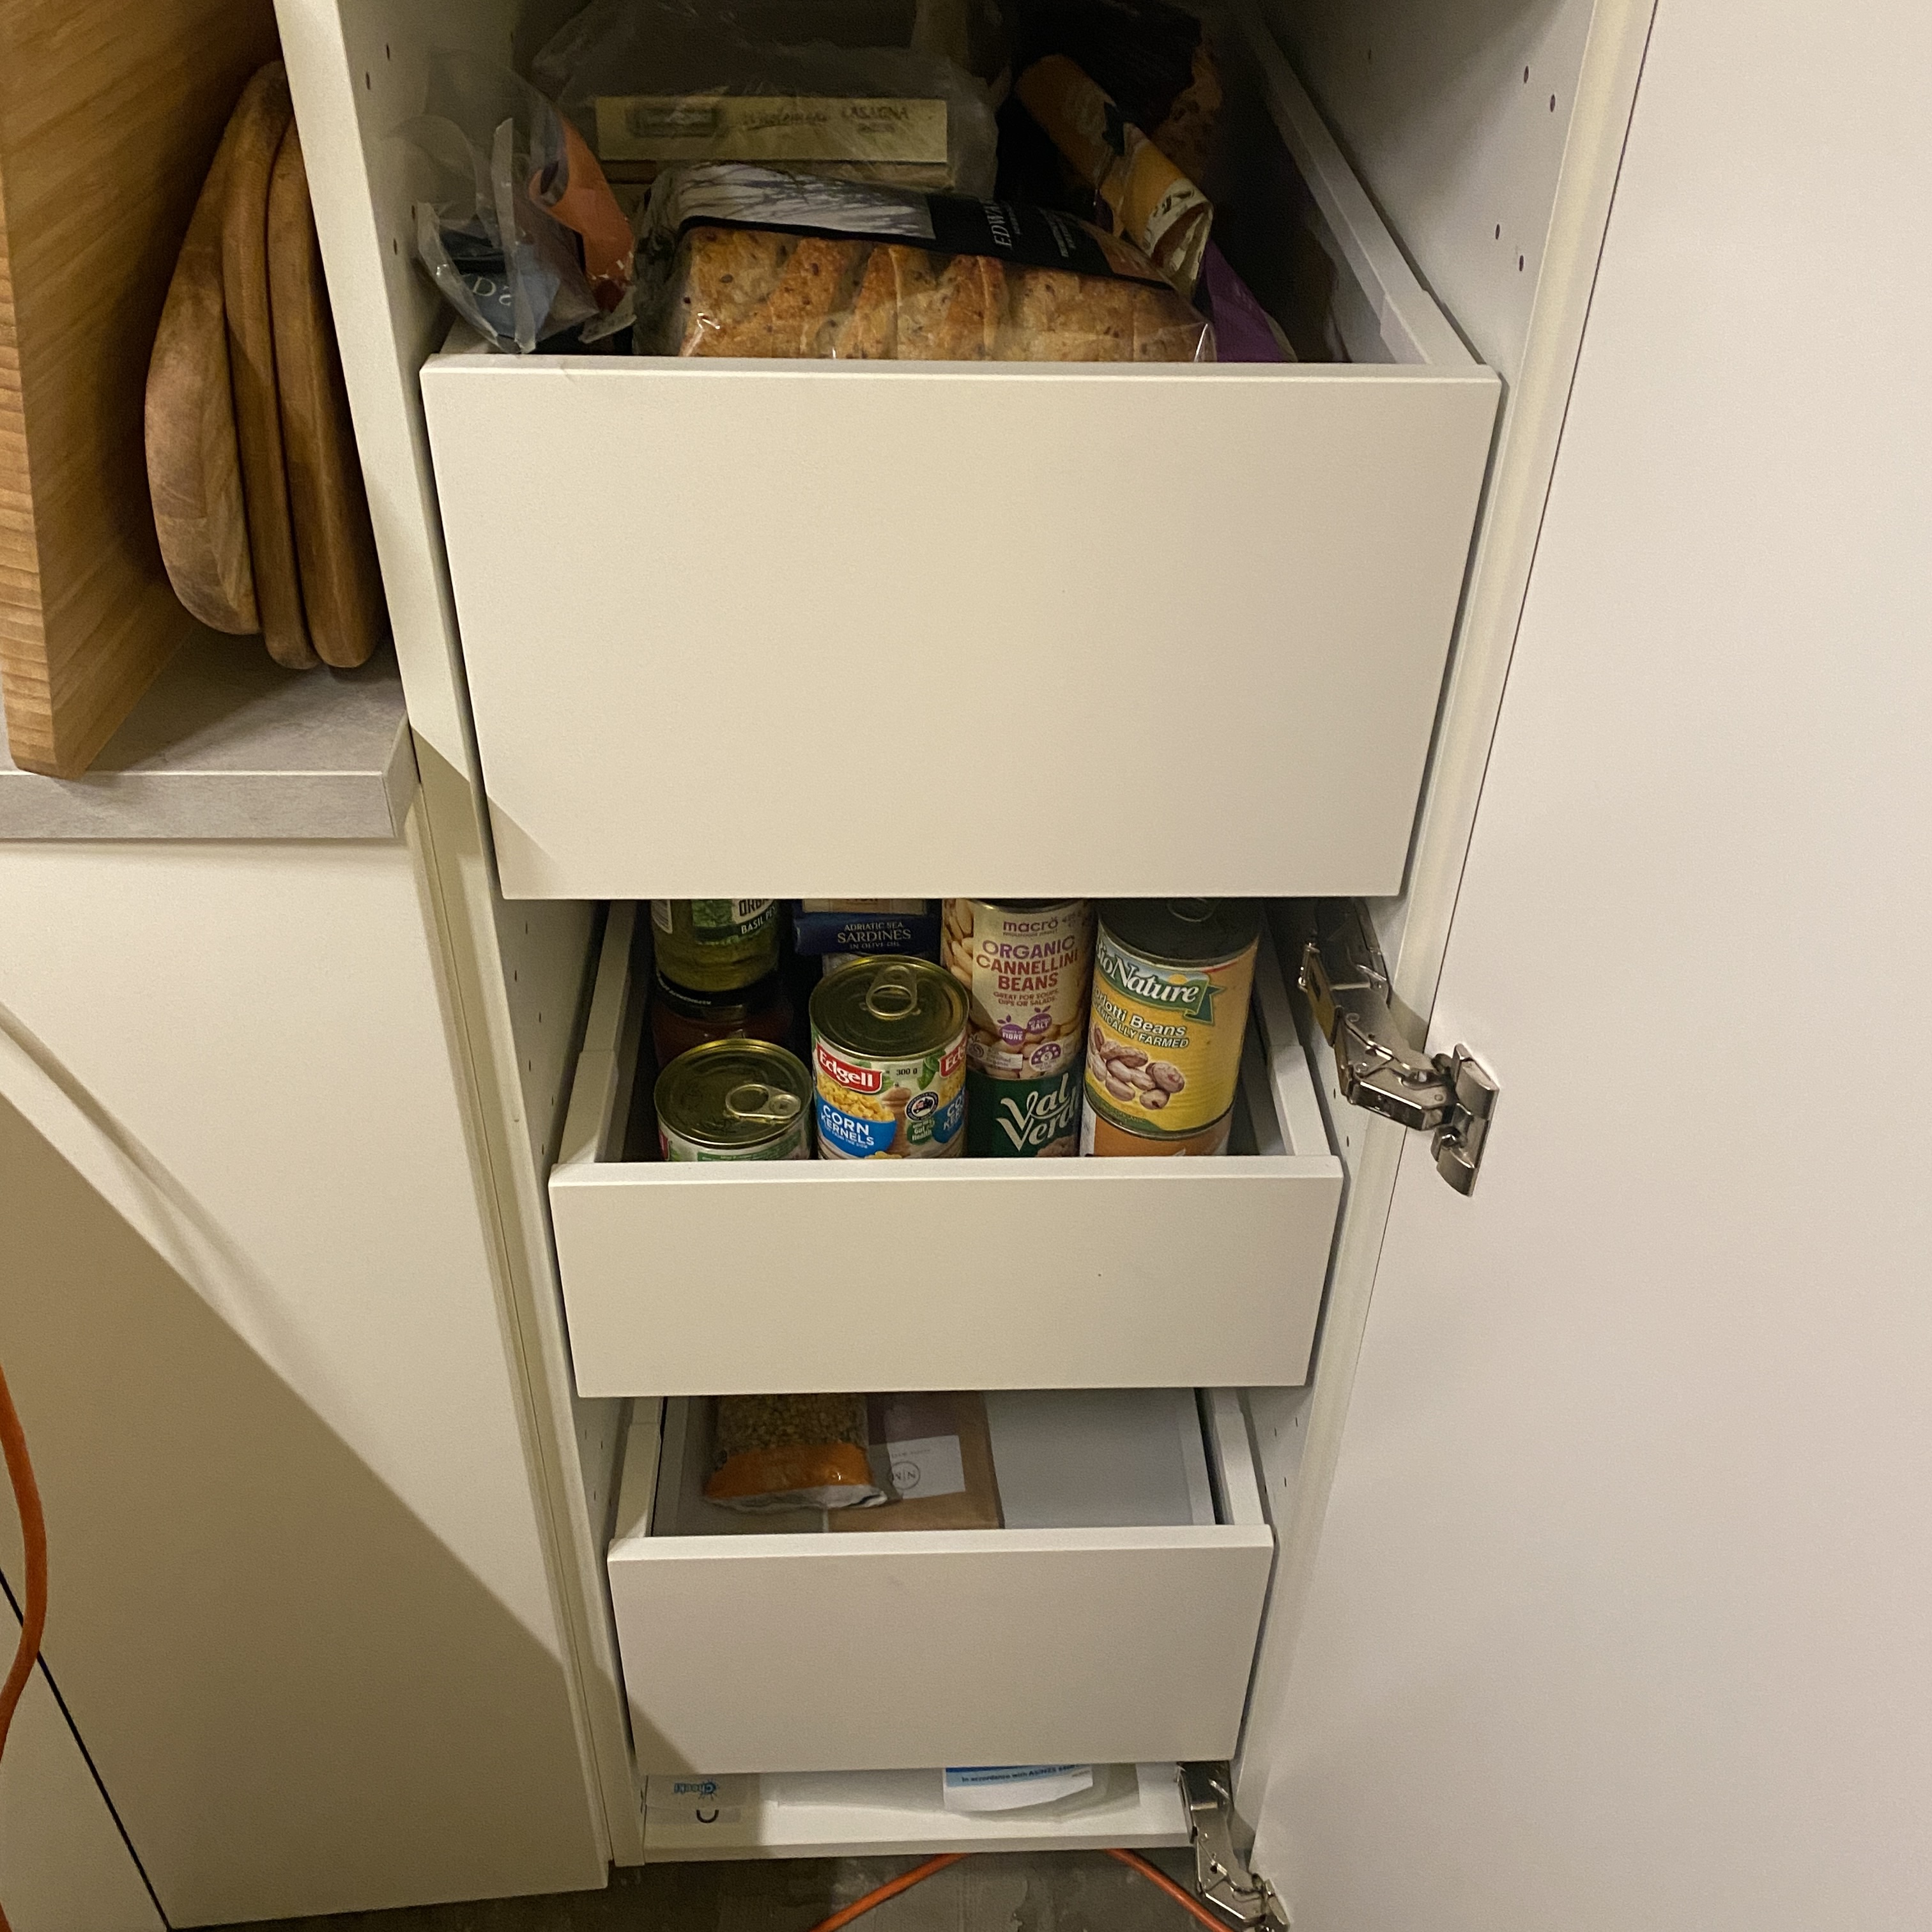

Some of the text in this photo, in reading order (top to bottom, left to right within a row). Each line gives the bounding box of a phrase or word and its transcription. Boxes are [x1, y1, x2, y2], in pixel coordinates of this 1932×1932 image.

[740, 918, 763, 935] BASIL
[837, 929, 912, 944] SARDINES
[844, 923, 884, 931] ADRIATIC
[982, 935, 1076, 960] ORGANIC
[976, 949, 1079, 976] CANNELLINI
[997, 972, 1059, 992] BEANS
[993, 992, 1017, 1000] GREAT
[1016, 999, 1029, 1007] OR
[1094, 984, 1187, 1036] orlotti Beans
[1030, 1022, 1048, 1031] SALT
[1093, 1002, 1190, 1048] ANICALLY FARMED
[1002, 1032, 1023, 1041] FIBRE
[818, 1049, 873, 1087] Edgell
[1000, 1073, 1070, 1131] Val
[820, 1112, 875, 1146] KERNELS
[822, 1105, 870, 1135] CORN
[970, 1774, 1011, 1782] accordance
